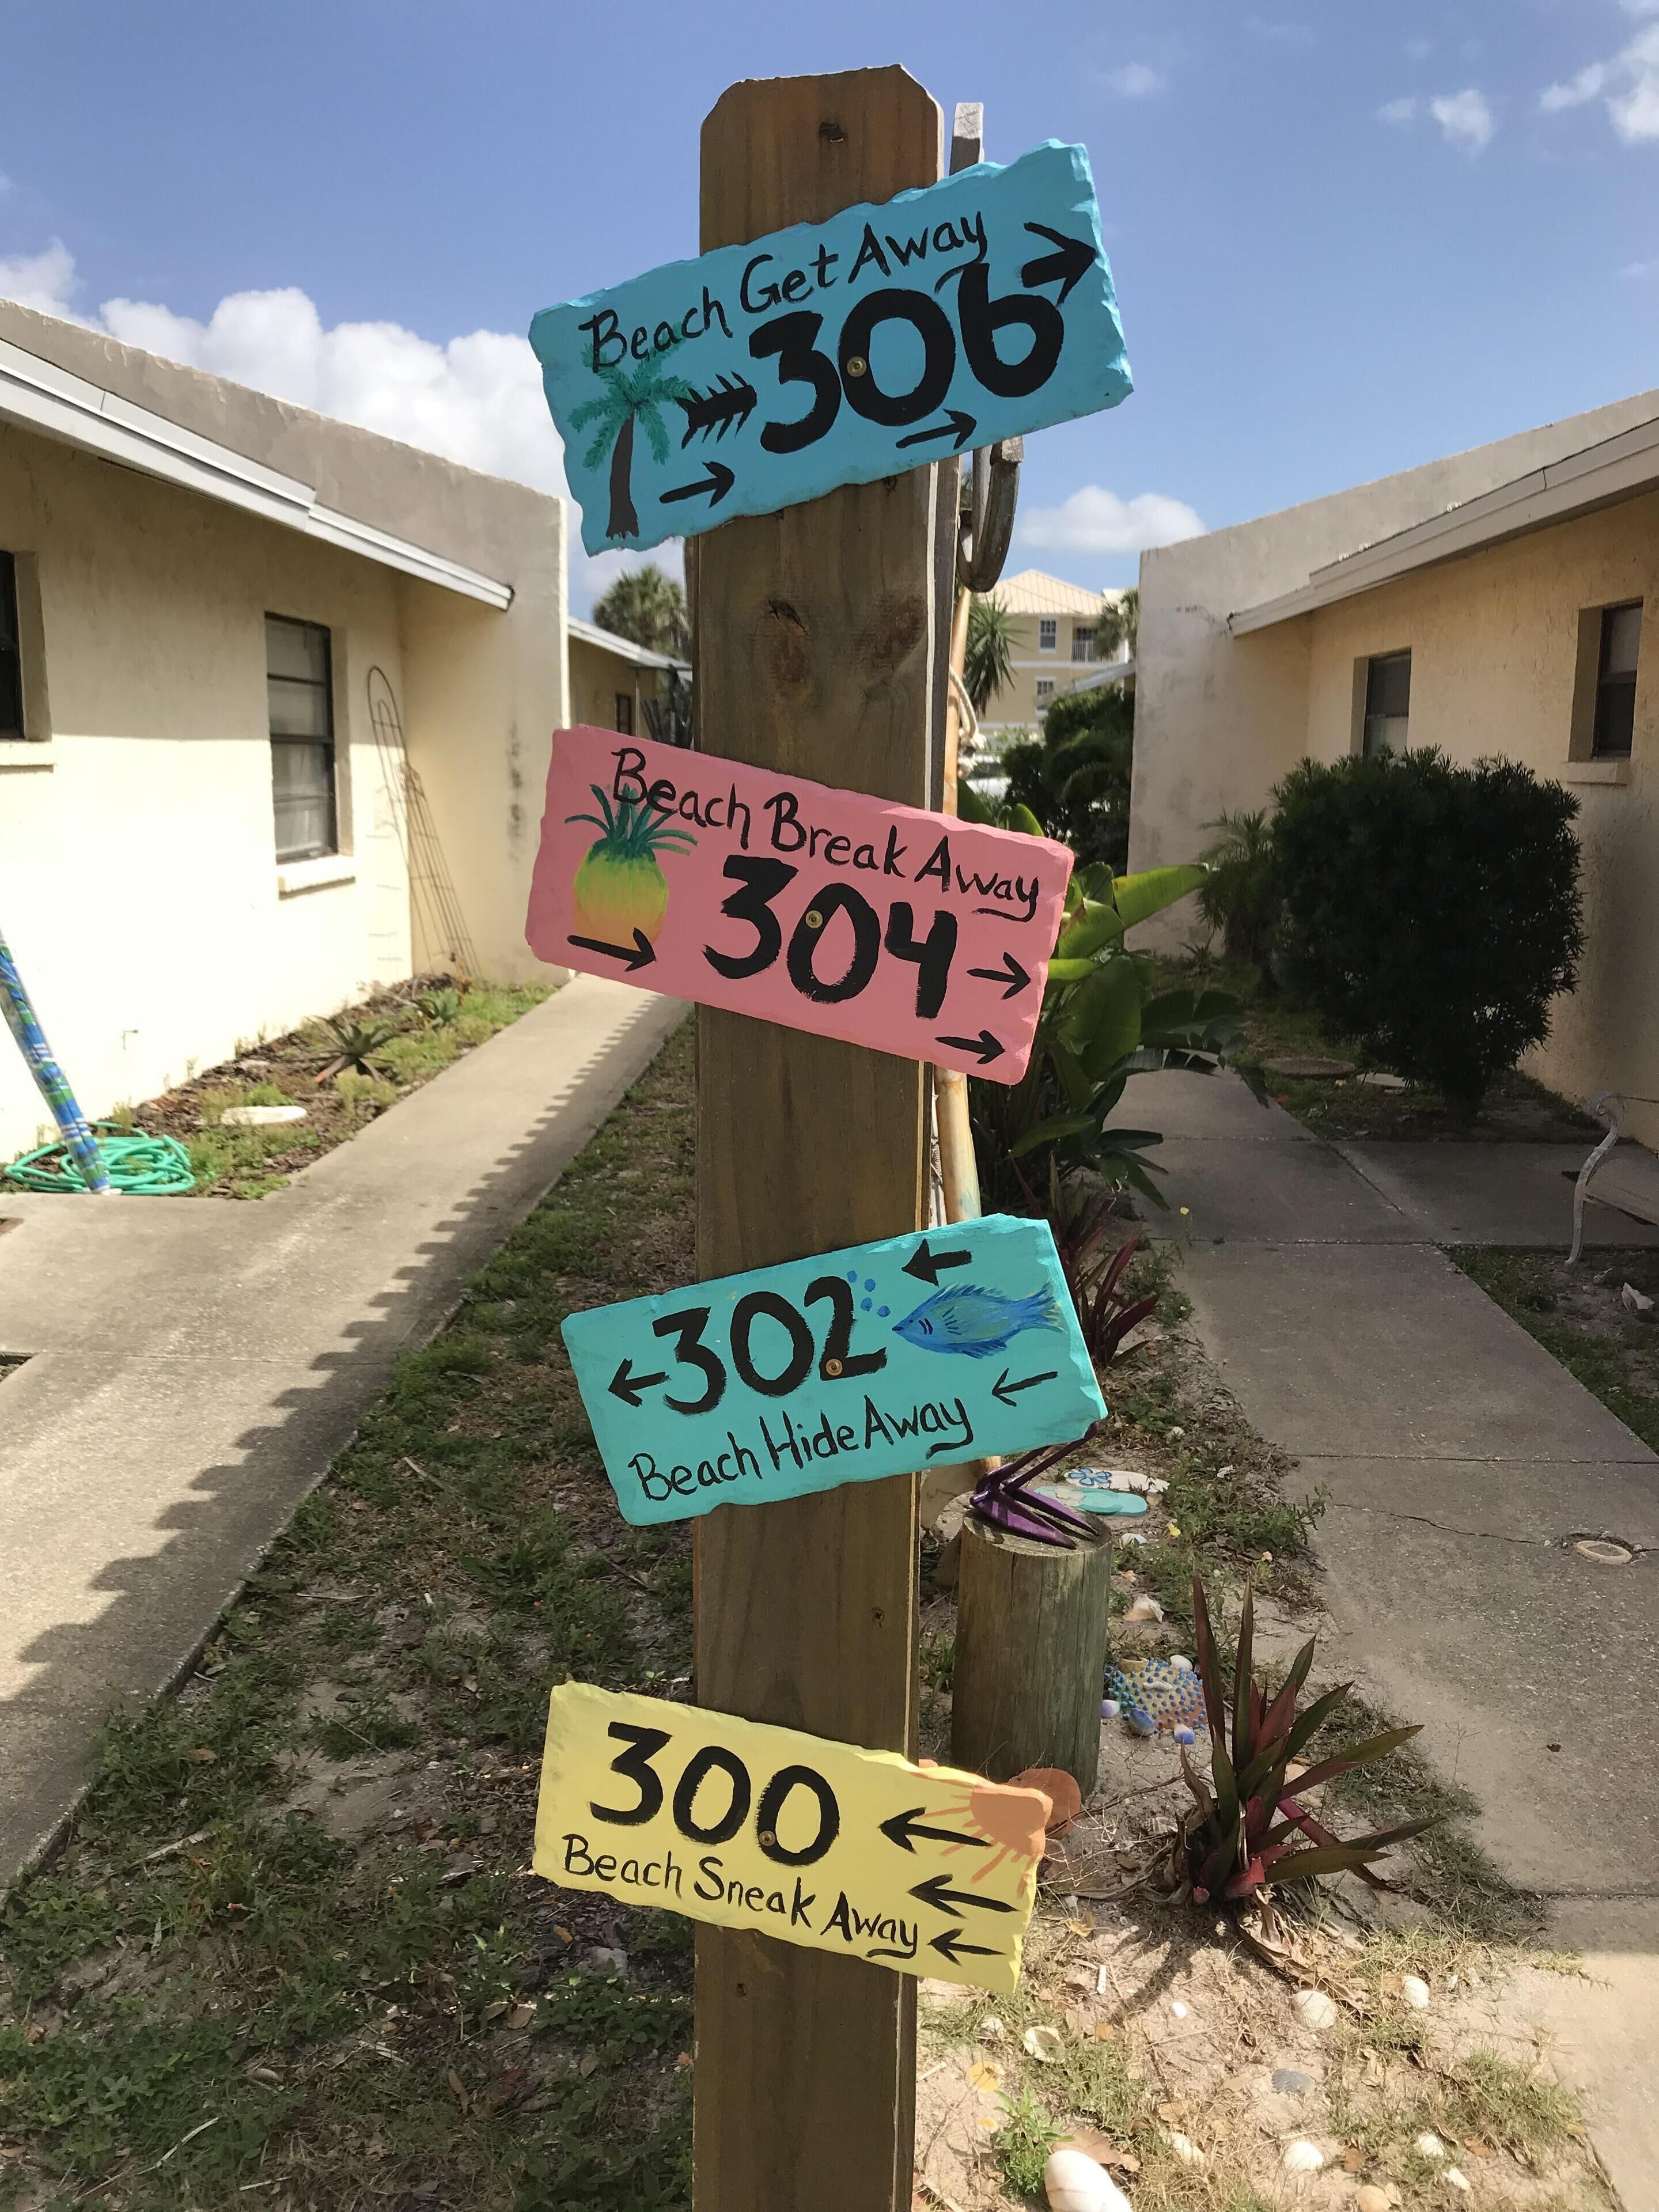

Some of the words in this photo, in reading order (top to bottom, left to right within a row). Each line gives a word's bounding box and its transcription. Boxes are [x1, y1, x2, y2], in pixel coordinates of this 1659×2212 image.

[578, 286, 733, 373] Beach
[740, 244, 839, 314] Get
[847, 211, 986, 293] Away
[748, 262, 1065, 454] 306
[612, 748, 750, 849] Beach
[764, 792, 908, 878] Break
[914, 835, 1039, 922] Away
[703, 855, 957, 1019] 304
[652, 1275, 887, 1415] 302
[628, 1431, 762, 1501] Beach
[759, 1410, 859, 1472] Hide
[864, 1395, 973, 1459] Away
[589, 1721, 840, 1867] 300
[561, 1834, 682, 1899] Beach
[694, 1857, 816, 1929] Sneak
[820, 1891, 919, 1958] Away
